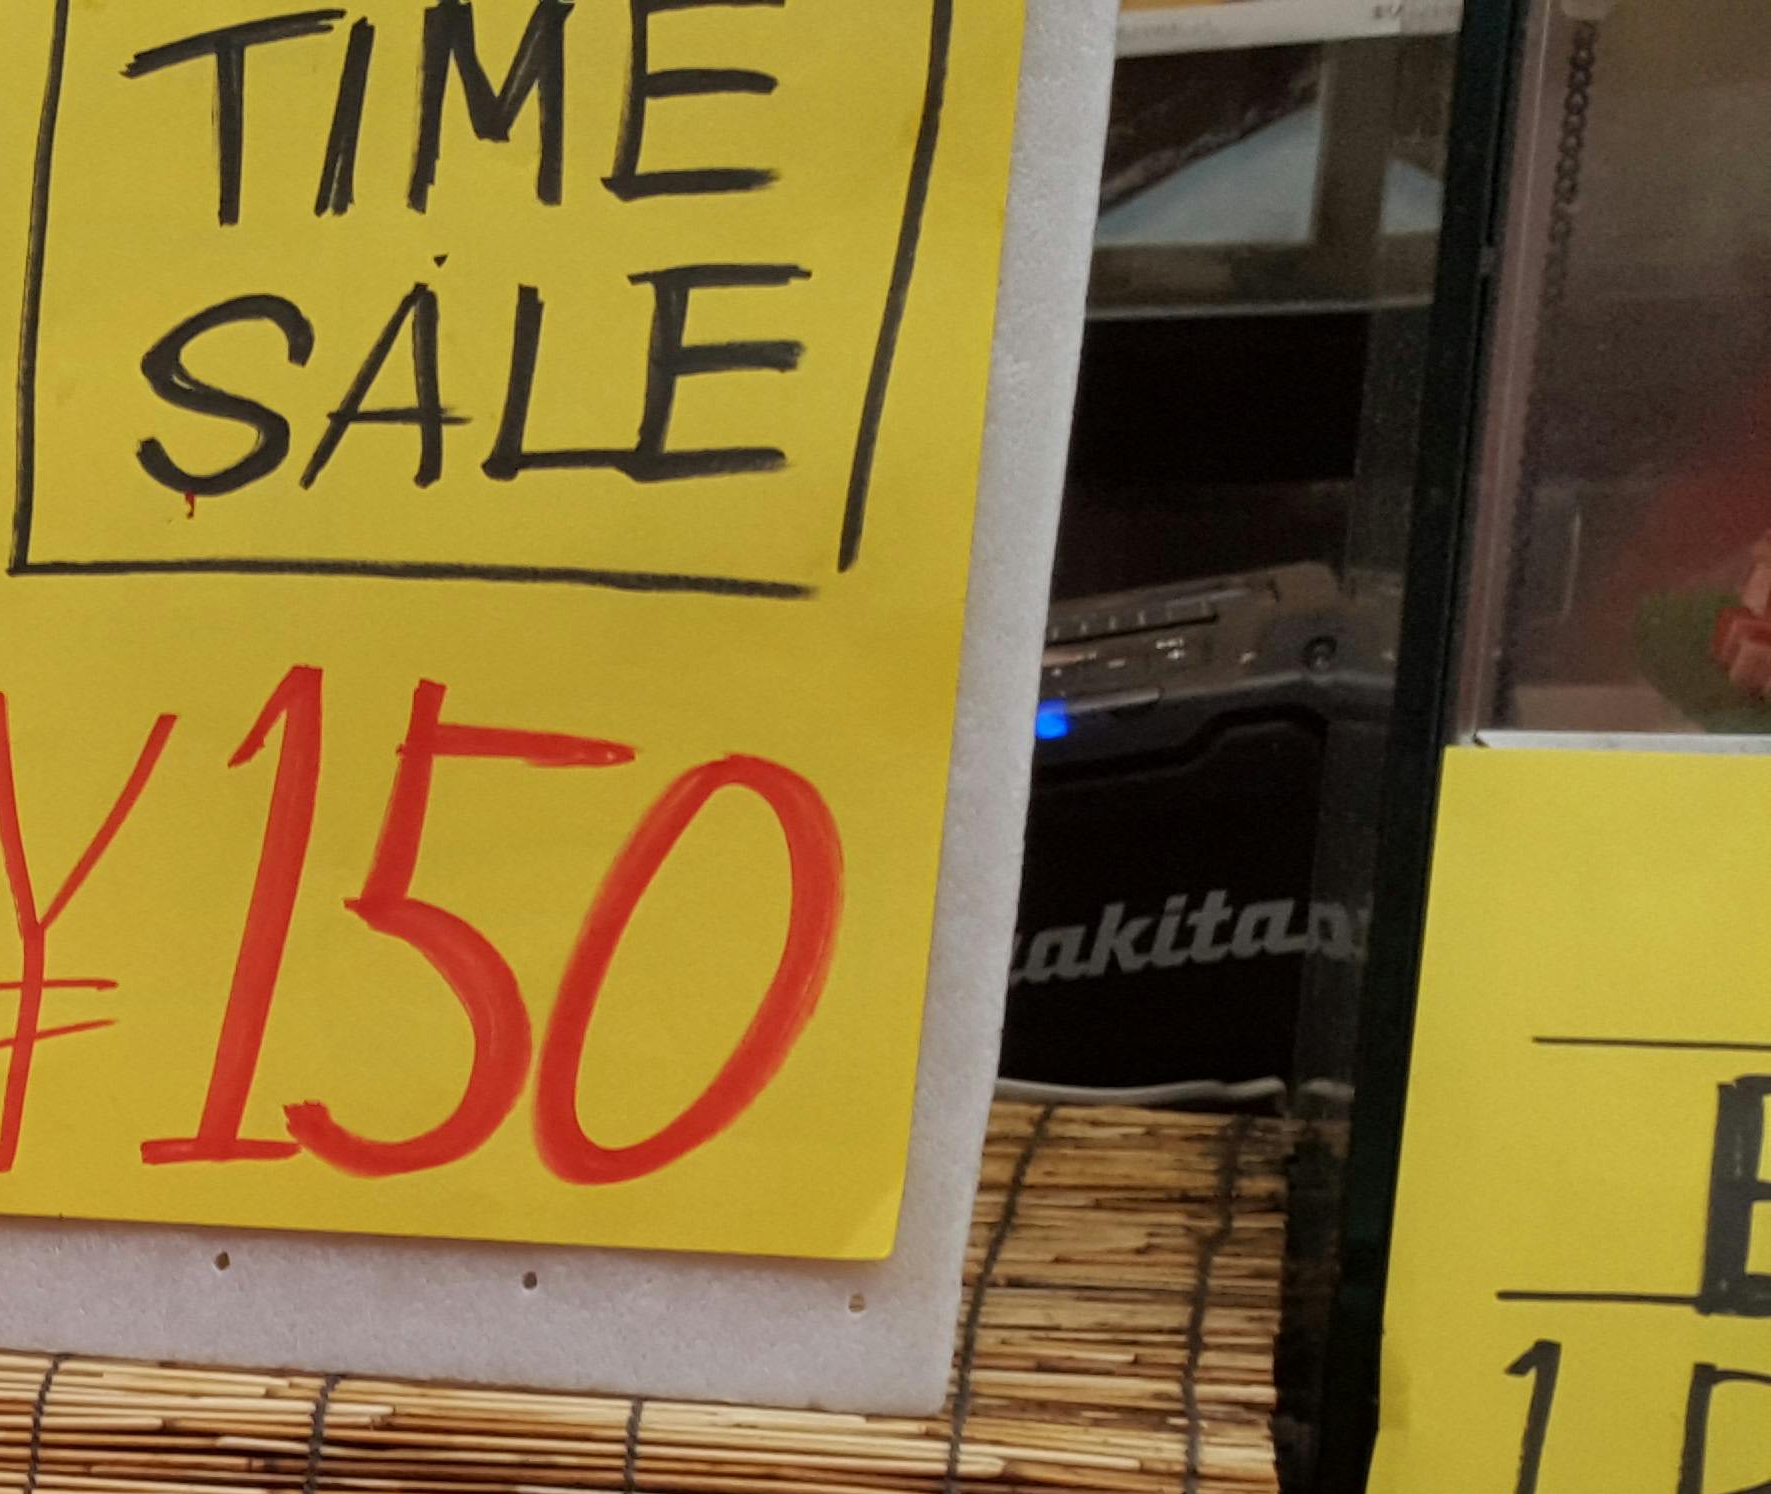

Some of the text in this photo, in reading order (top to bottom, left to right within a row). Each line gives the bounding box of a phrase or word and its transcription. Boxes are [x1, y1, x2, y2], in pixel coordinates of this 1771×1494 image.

[122, 0, 782, 226] TIME
[136, 260, 813, 498] SALE
[1009, 888, 1311, 985] akita
